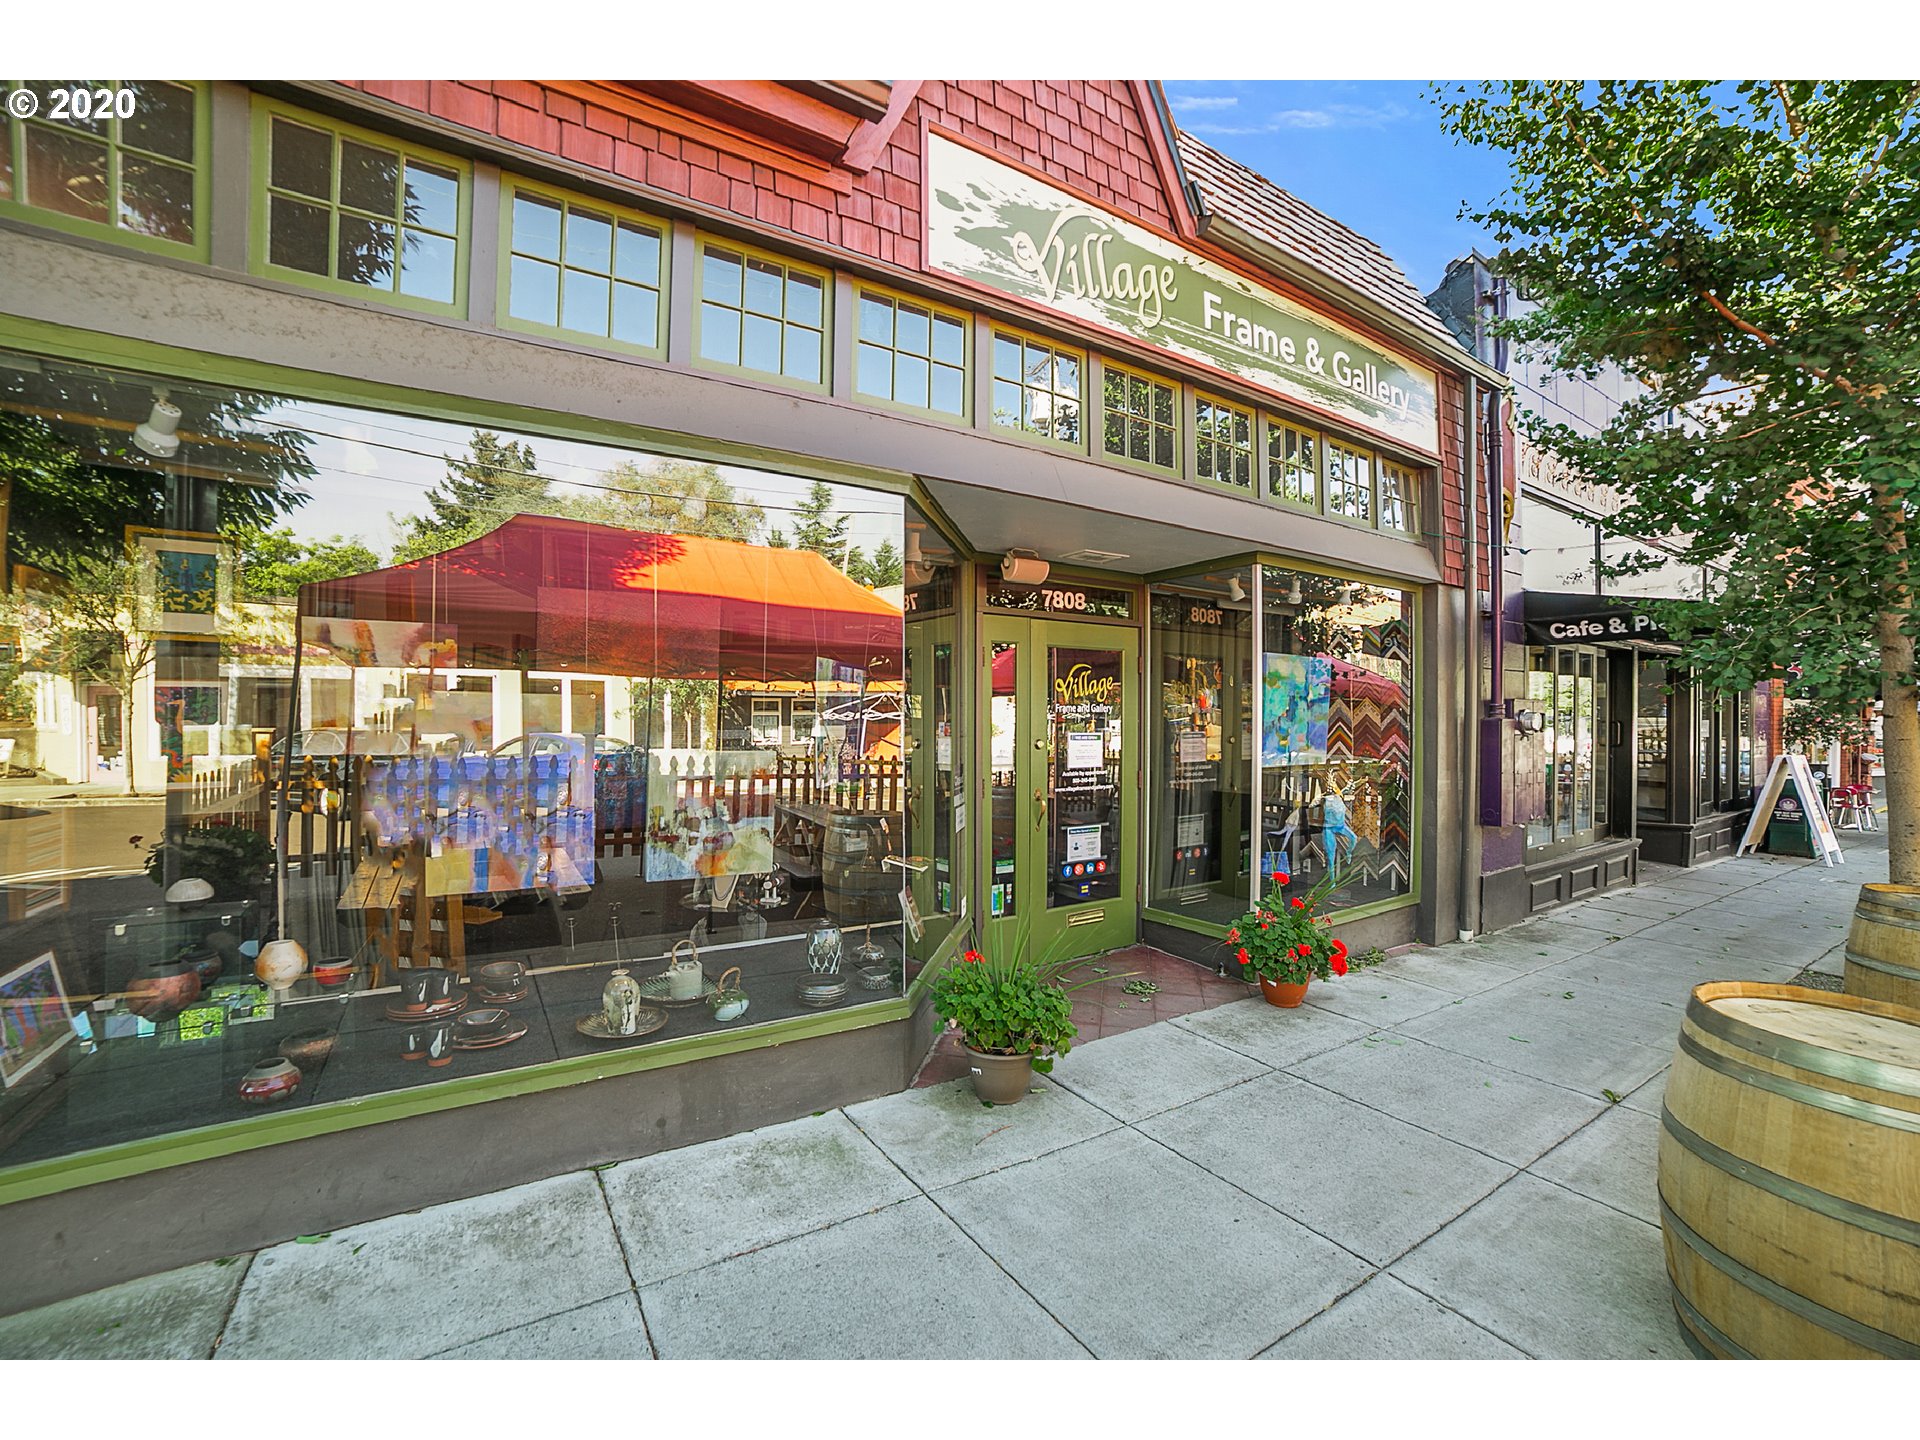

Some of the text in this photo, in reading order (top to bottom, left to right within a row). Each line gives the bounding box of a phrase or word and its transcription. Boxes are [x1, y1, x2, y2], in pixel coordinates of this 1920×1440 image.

[1012, 206, 1411, 421] Village Frame & Gallery
[1041, 588, 1086, 611] 7808
[1550, 619, 1604, 639] Cafe
[1608, 617, 1628, 634] &
[1055, 663, 1114, 703] Village
[1055, 703, 1113, 715] Frame and Gallery
